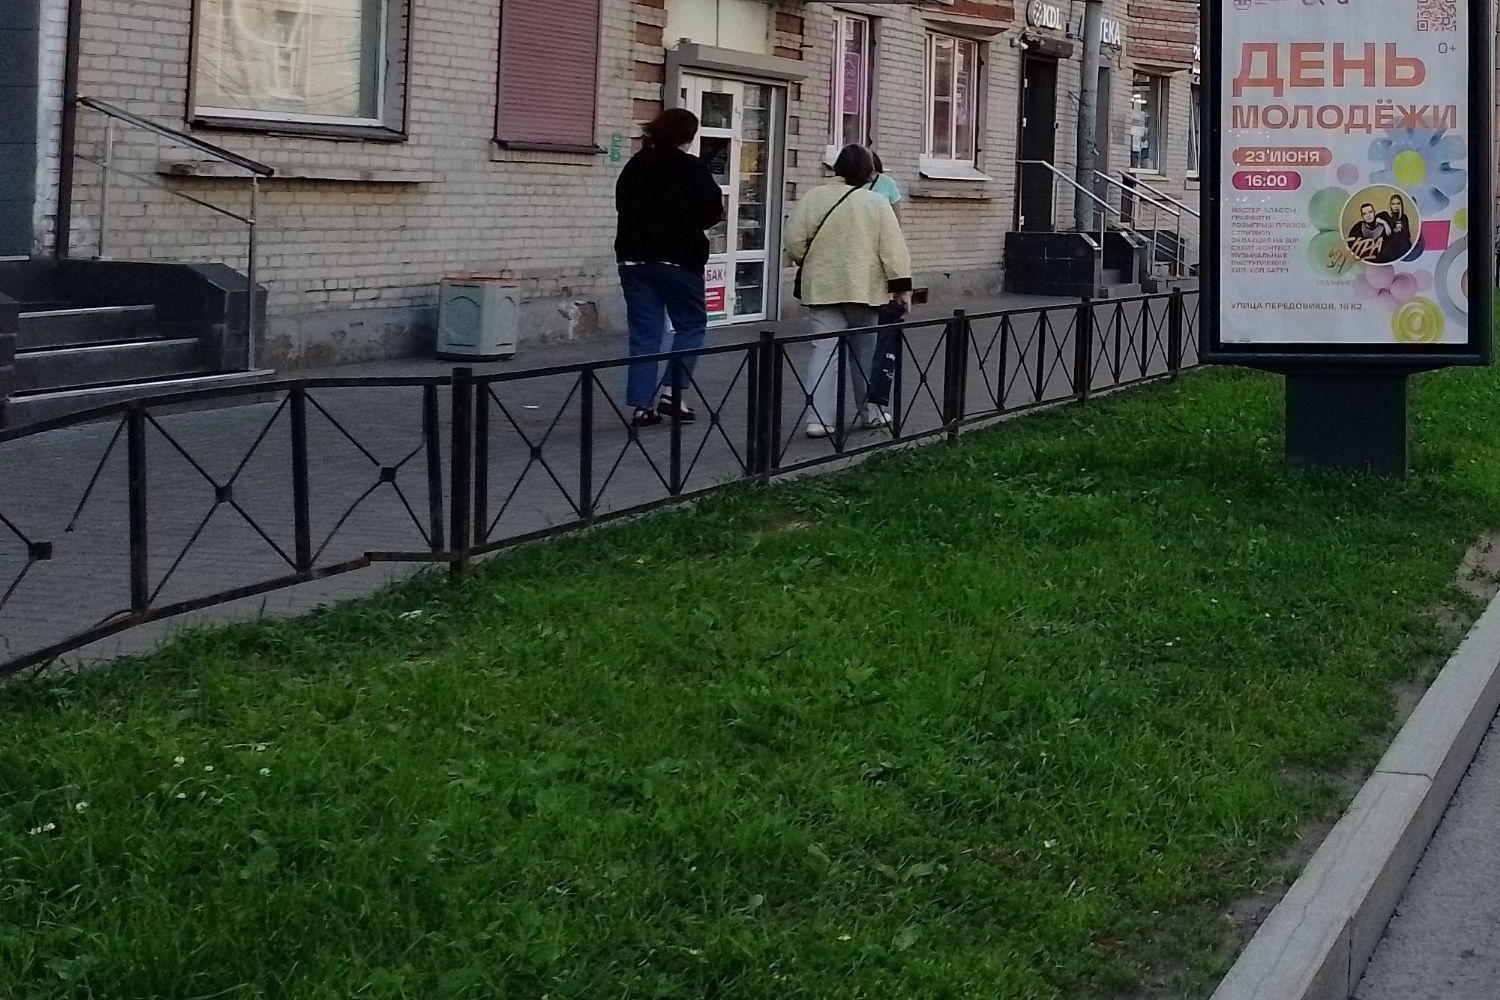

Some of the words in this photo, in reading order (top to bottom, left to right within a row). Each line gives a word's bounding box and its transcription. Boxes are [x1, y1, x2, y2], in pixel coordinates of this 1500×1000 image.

[1042, 3, 1062, 30] KDL
[1100, 18, 1121, 46] ТЕКА
[1437, 42, 1457, 54] 0+
[1232, 42, 1427, 98] ДЕНЬ
[1231, 99, 1458, 135] МОЛОДЁЖИ
[1244, 151, 1265, 163] 23
[1269, 151, 1321, 163] ИЮНЯ
[1244, 174, 1288, 187] 16:00
[1230, 302, 1263, 311] УЛИЦА
